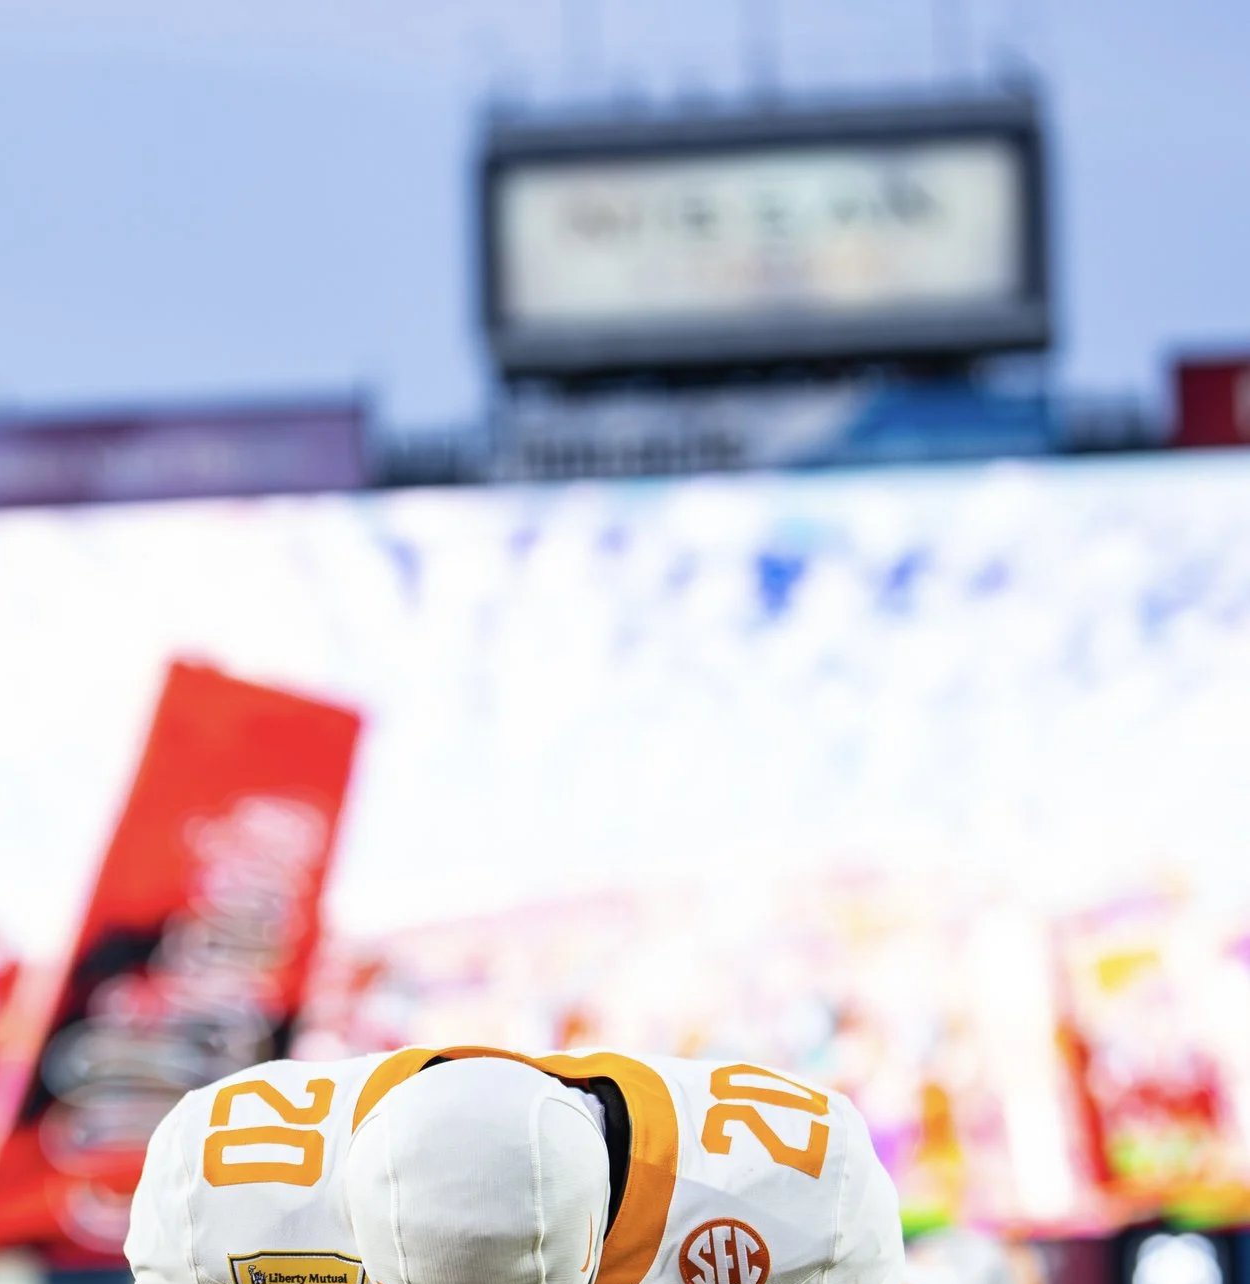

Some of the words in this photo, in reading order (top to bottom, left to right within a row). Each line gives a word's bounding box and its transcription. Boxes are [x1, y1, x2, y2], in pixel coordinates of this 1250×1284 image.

[203, 1077, 335, 1187] 20
[702, 1064, 829, 1180] 20
[269, 1274, 306, 1284] Liberty
[309, 1273, 348, 1283] Mutual
